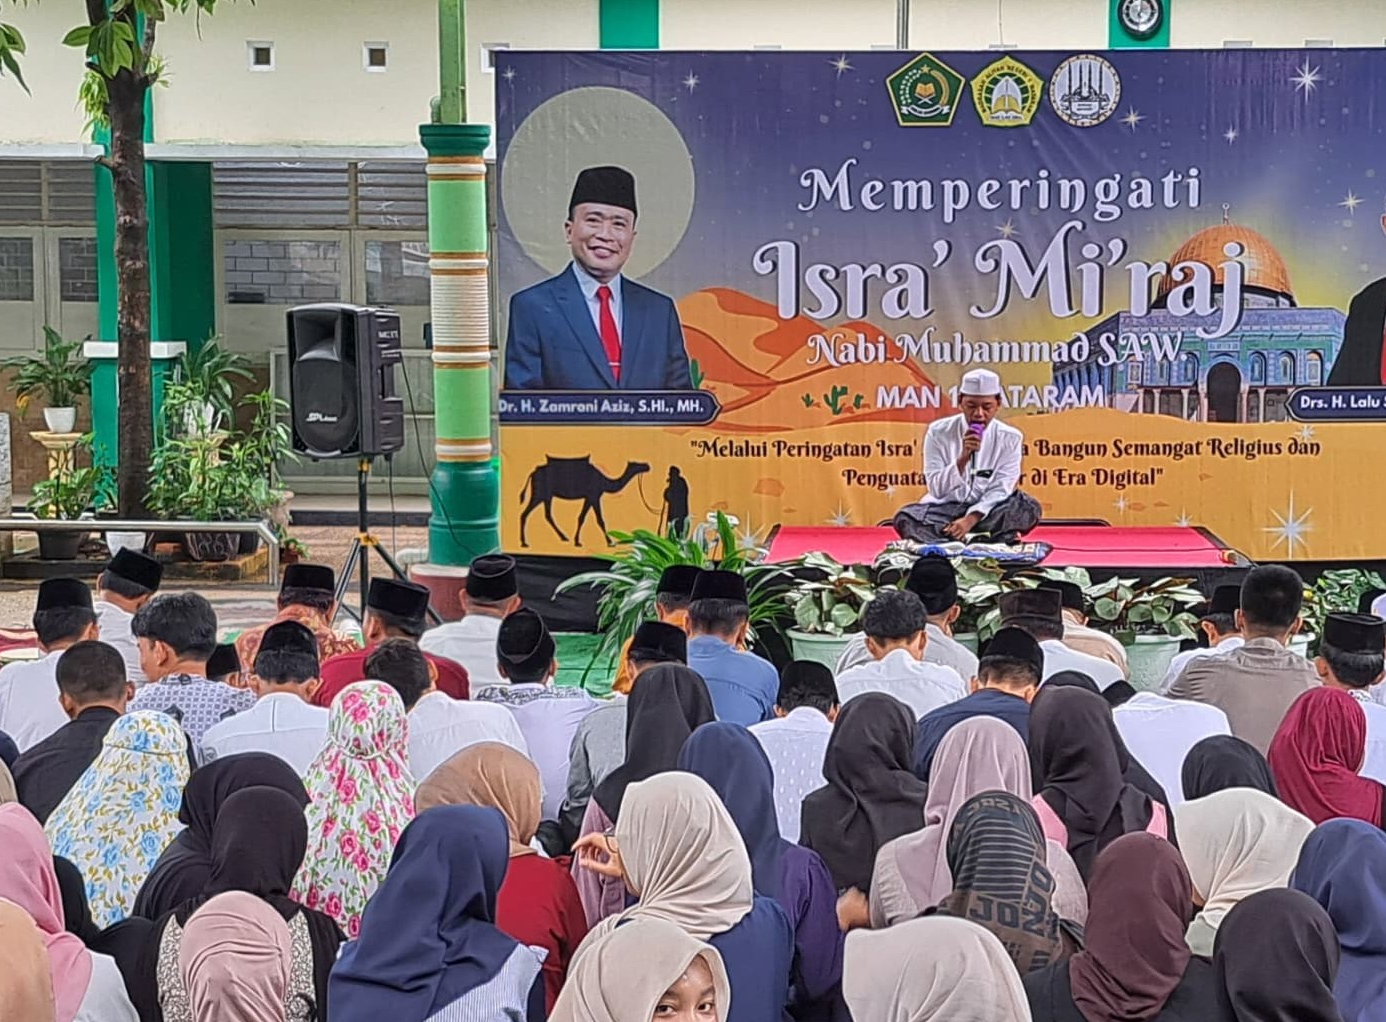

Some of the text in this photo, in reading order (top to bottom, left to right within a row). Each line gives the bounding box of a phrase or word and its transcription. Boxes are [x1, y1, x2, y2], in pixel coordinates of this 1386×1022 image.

[798, 159, 1201, 222] Memperingati
[752, 221, 1247, 338] Isra' Mi'raj
[806, 331, 1189, 366] Nabi Muhammad SAW.
[499, 399, 518, 413] Dr.
[521, 399, 535, 413] H.
[600, 399, 634, 415] Aziz,
[676, 399, 704, 413] MH.
[877, 385, 941, 409] MAN
[997, 385, 1104, 408] ATARAM
[1300, 395, 1328, 409] Drs.
[1332, 395, 1347, 409] H.
[1350, 395, 1380, 409] Lalu
[690, 436, 917, 462] "Melalui Peringatan Isra'
[1033, 438, 1108, 460] Bangun
[1112, 438, 1203, 460] Semangat
[1206, 437, 1283, 460] Religius
[1288, 437, 1321, 456] dan
[842, 469, 927, 491] Penguata
[1031, 467, 1048, 486] di
[1052, 468, 1087, 486] Era
[1090, 467, 1164, 490] Digital"
